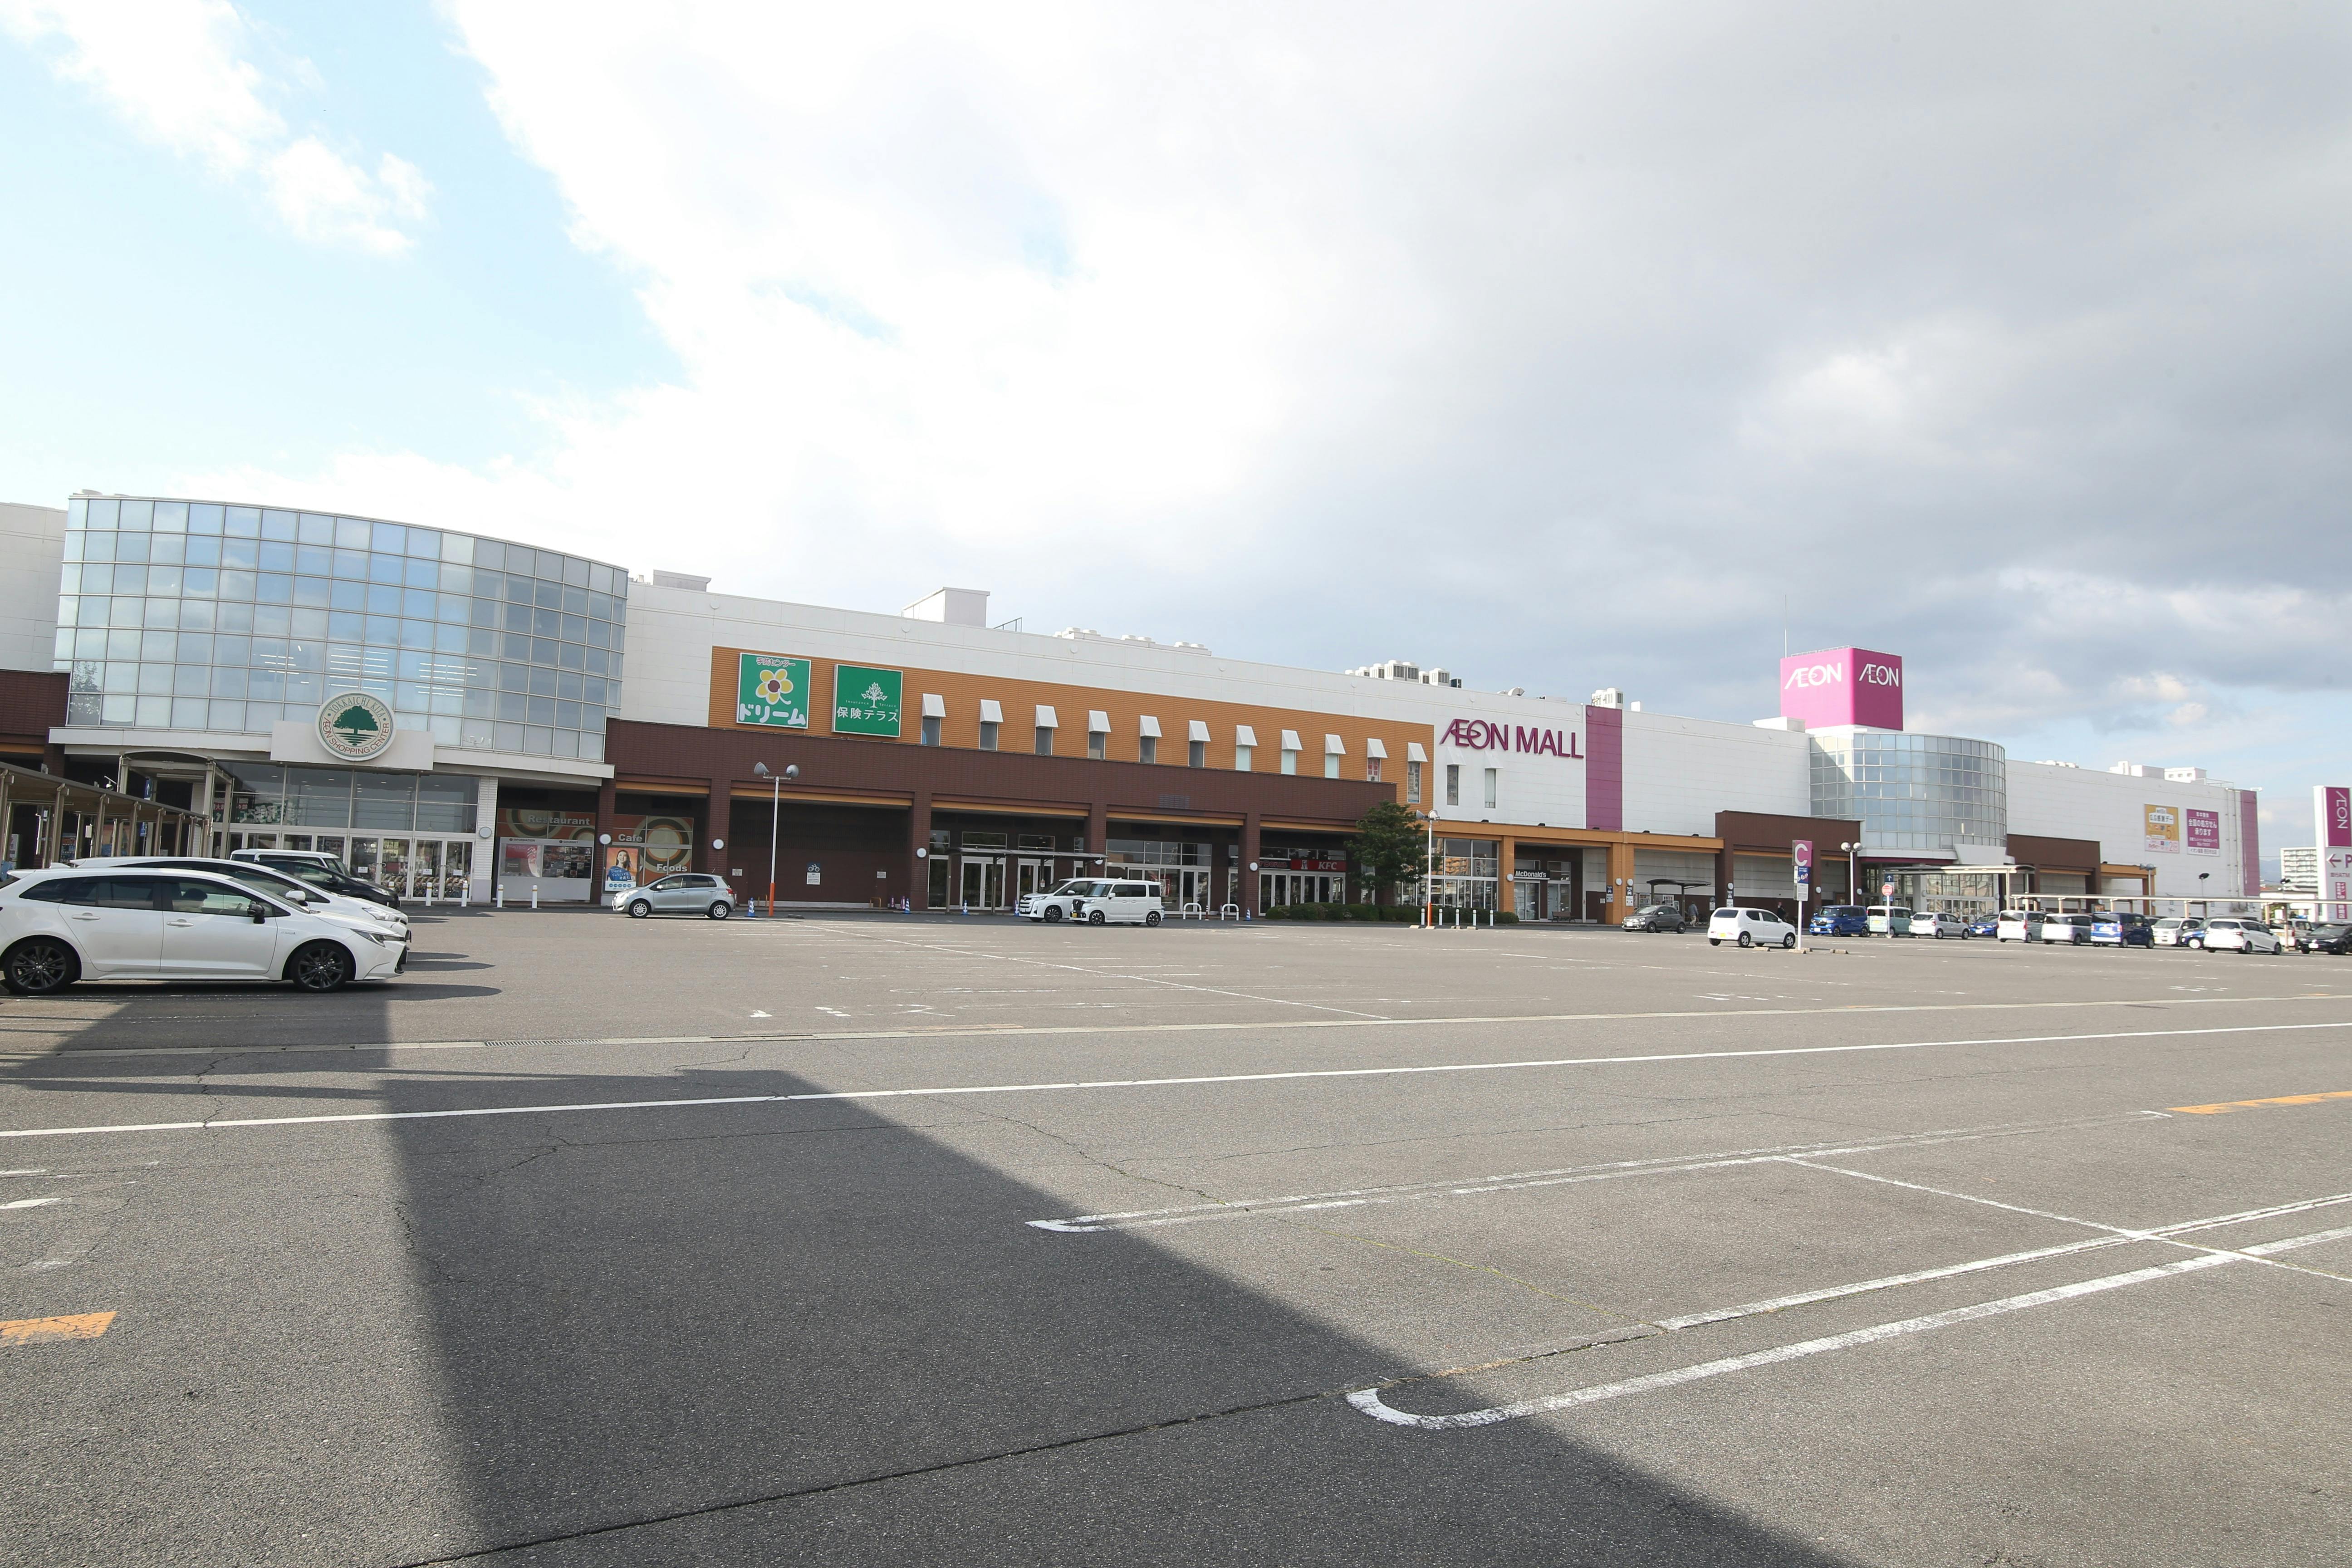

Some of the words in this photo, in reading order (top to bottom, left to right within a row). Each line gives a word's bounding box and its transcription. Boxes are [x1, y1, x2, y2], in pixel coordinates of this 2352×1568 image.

[756, 657, 796, 667] 手芸センター
[328, 696, 370, 713] YOKKAICHI
[370, 702, 386, 717] KITA
[739, 703, 806, 725] ドリーム
[837, 706, 898, 722] 保険テラス
[329, 738, 371, 755] SHOPPING
[370, 722, 390, 750] CENTER
[1516, 726, 1583, 759] MALL
[528, 815, 590, 825] Restaurant
[618, 833, 643, 842] Cafe
[1795, 843, 1808, 867] C
[2345, 854, 2352, 868] P
[657, 863, 688, 872] Foods
